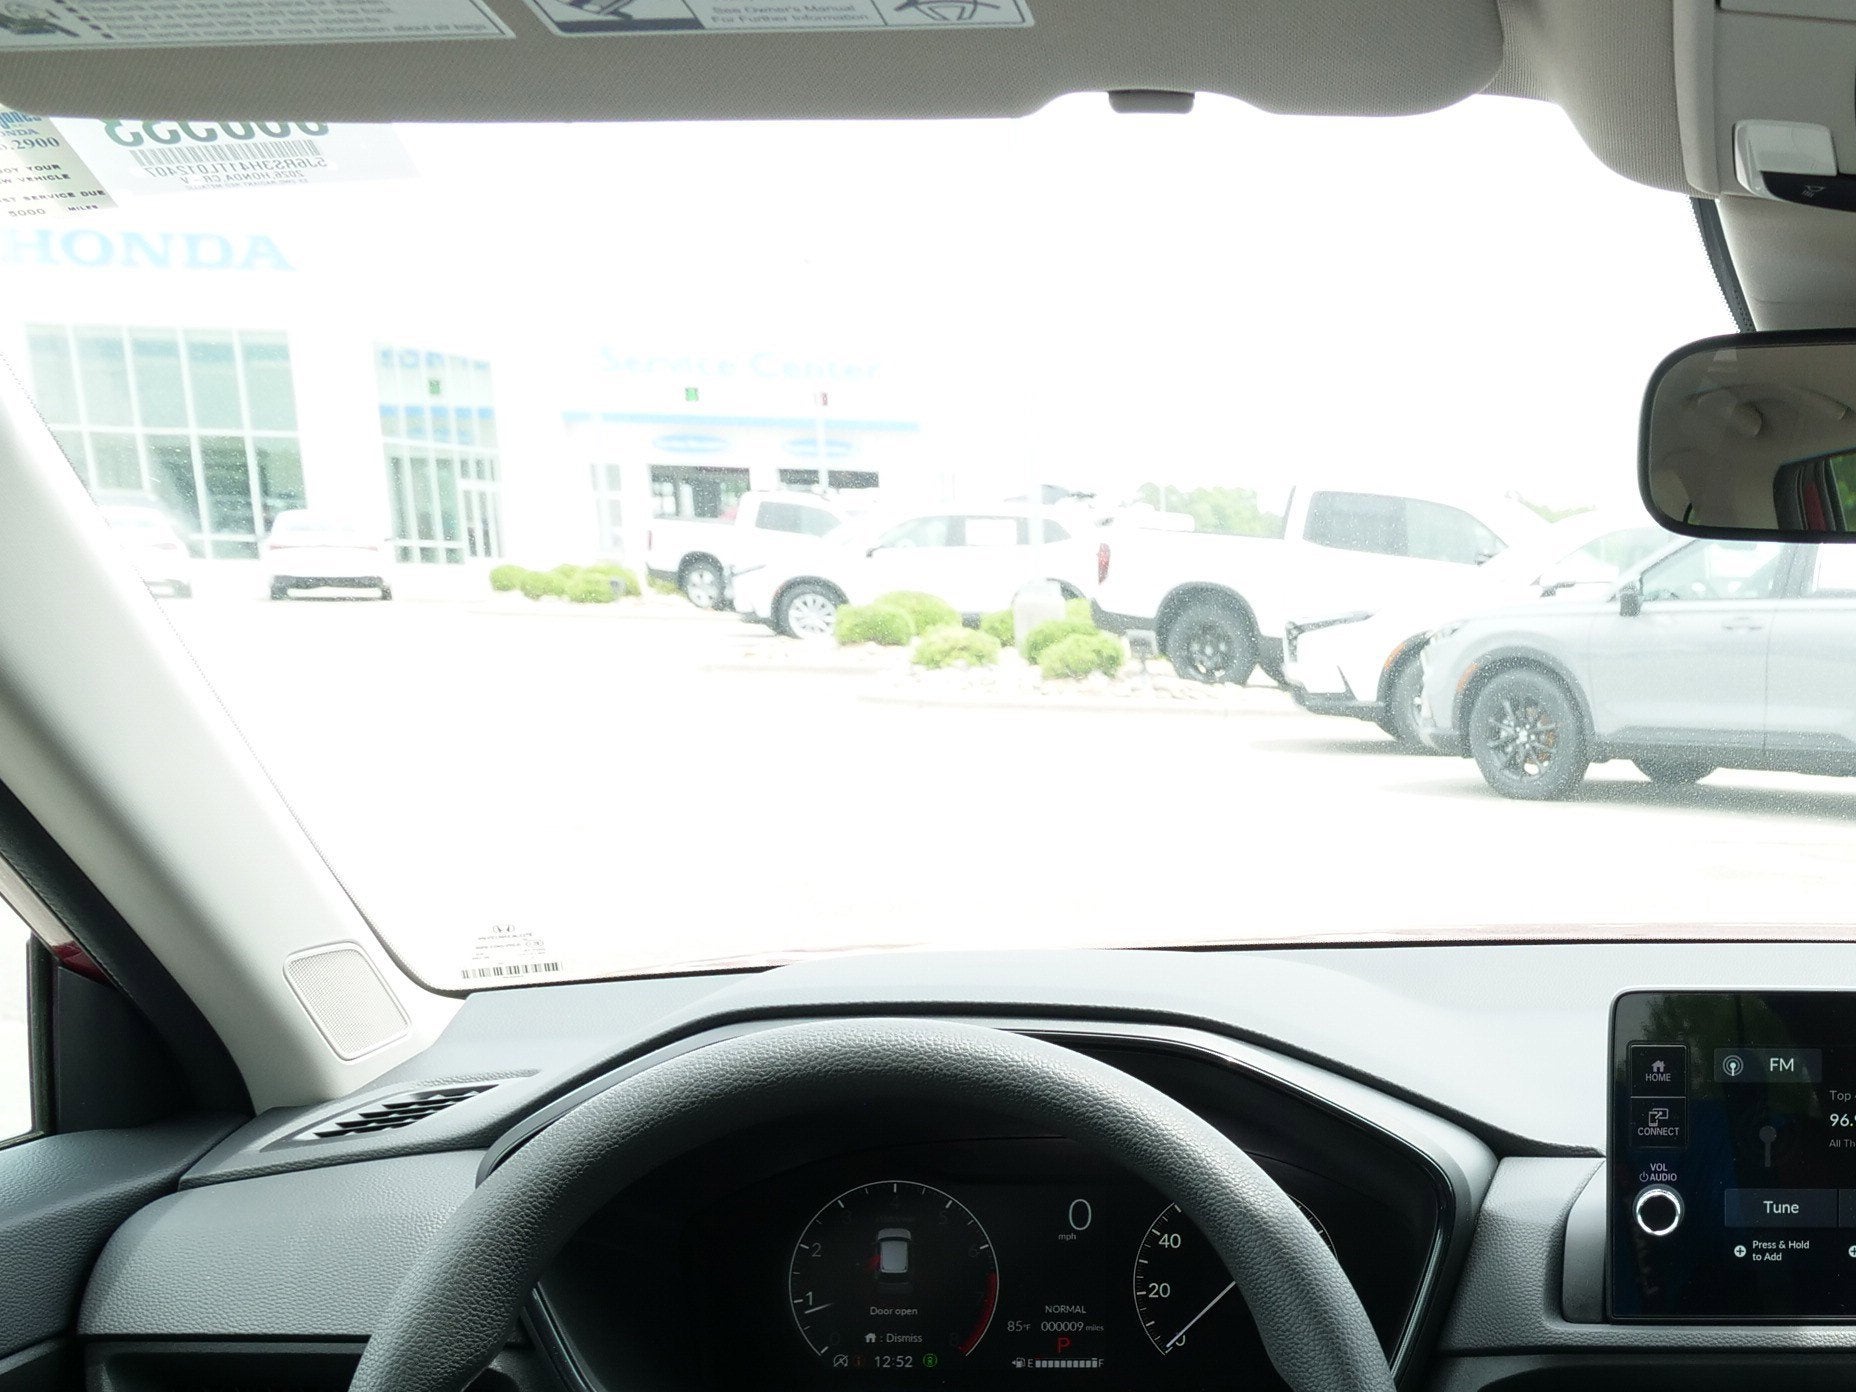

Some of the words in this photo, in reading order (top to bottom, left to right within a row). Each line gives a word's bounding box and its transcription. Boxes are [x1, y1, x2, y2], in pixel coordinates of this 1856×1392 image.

[16, 174, 71, 182] VEHICLE
[23, 192, 76, 201] SERVICE
[0, 226, 300, 272] HONDA
[598, 344, 736, 377] Service
[750, 351, 880, 380] Center
[1770, 1058, 1794, 1071] FM
[1829, 1091, 1851, 1102] Top
[1637, 1127, 1679, 1136] CONNECT
[1829, 1139, 1841, 1148] All
[1650, 1163, 1668, 1171] VOL
[1650, 1172, 1677, 1181] AUDIO
[1763, 1201, 1799, 1215] Tune
[1069, 1199, 1092, 1231] 0
[1058, 1233, 1077, 1241] mph
[1158, 1233, 1182, 1248] 40
[811, 1243, 822, 1257] 2
[1753, 1240, 1777, 1250] Press
[1789, 1240, 1810, 1251] Hold
[1753, 1253, 1763, 1262] to
[1766, 1252, 1782, 1262] Add
[1148, 1283, 1171, 1298] 20
[805, 1291, 813, 1306] 1
[870, 1306, 892, 1315] Door
[895, 1307, 918, 1317] open
[1045, 1305, 1087, 1314] NORMAL
[1041, 1322, 1083, 1331] 000009
[886, 1334, 922, 1343] Dismiss
[1057, 1337, 1071, 1353] P
[874, 1355, 913, 1368] 12:52
